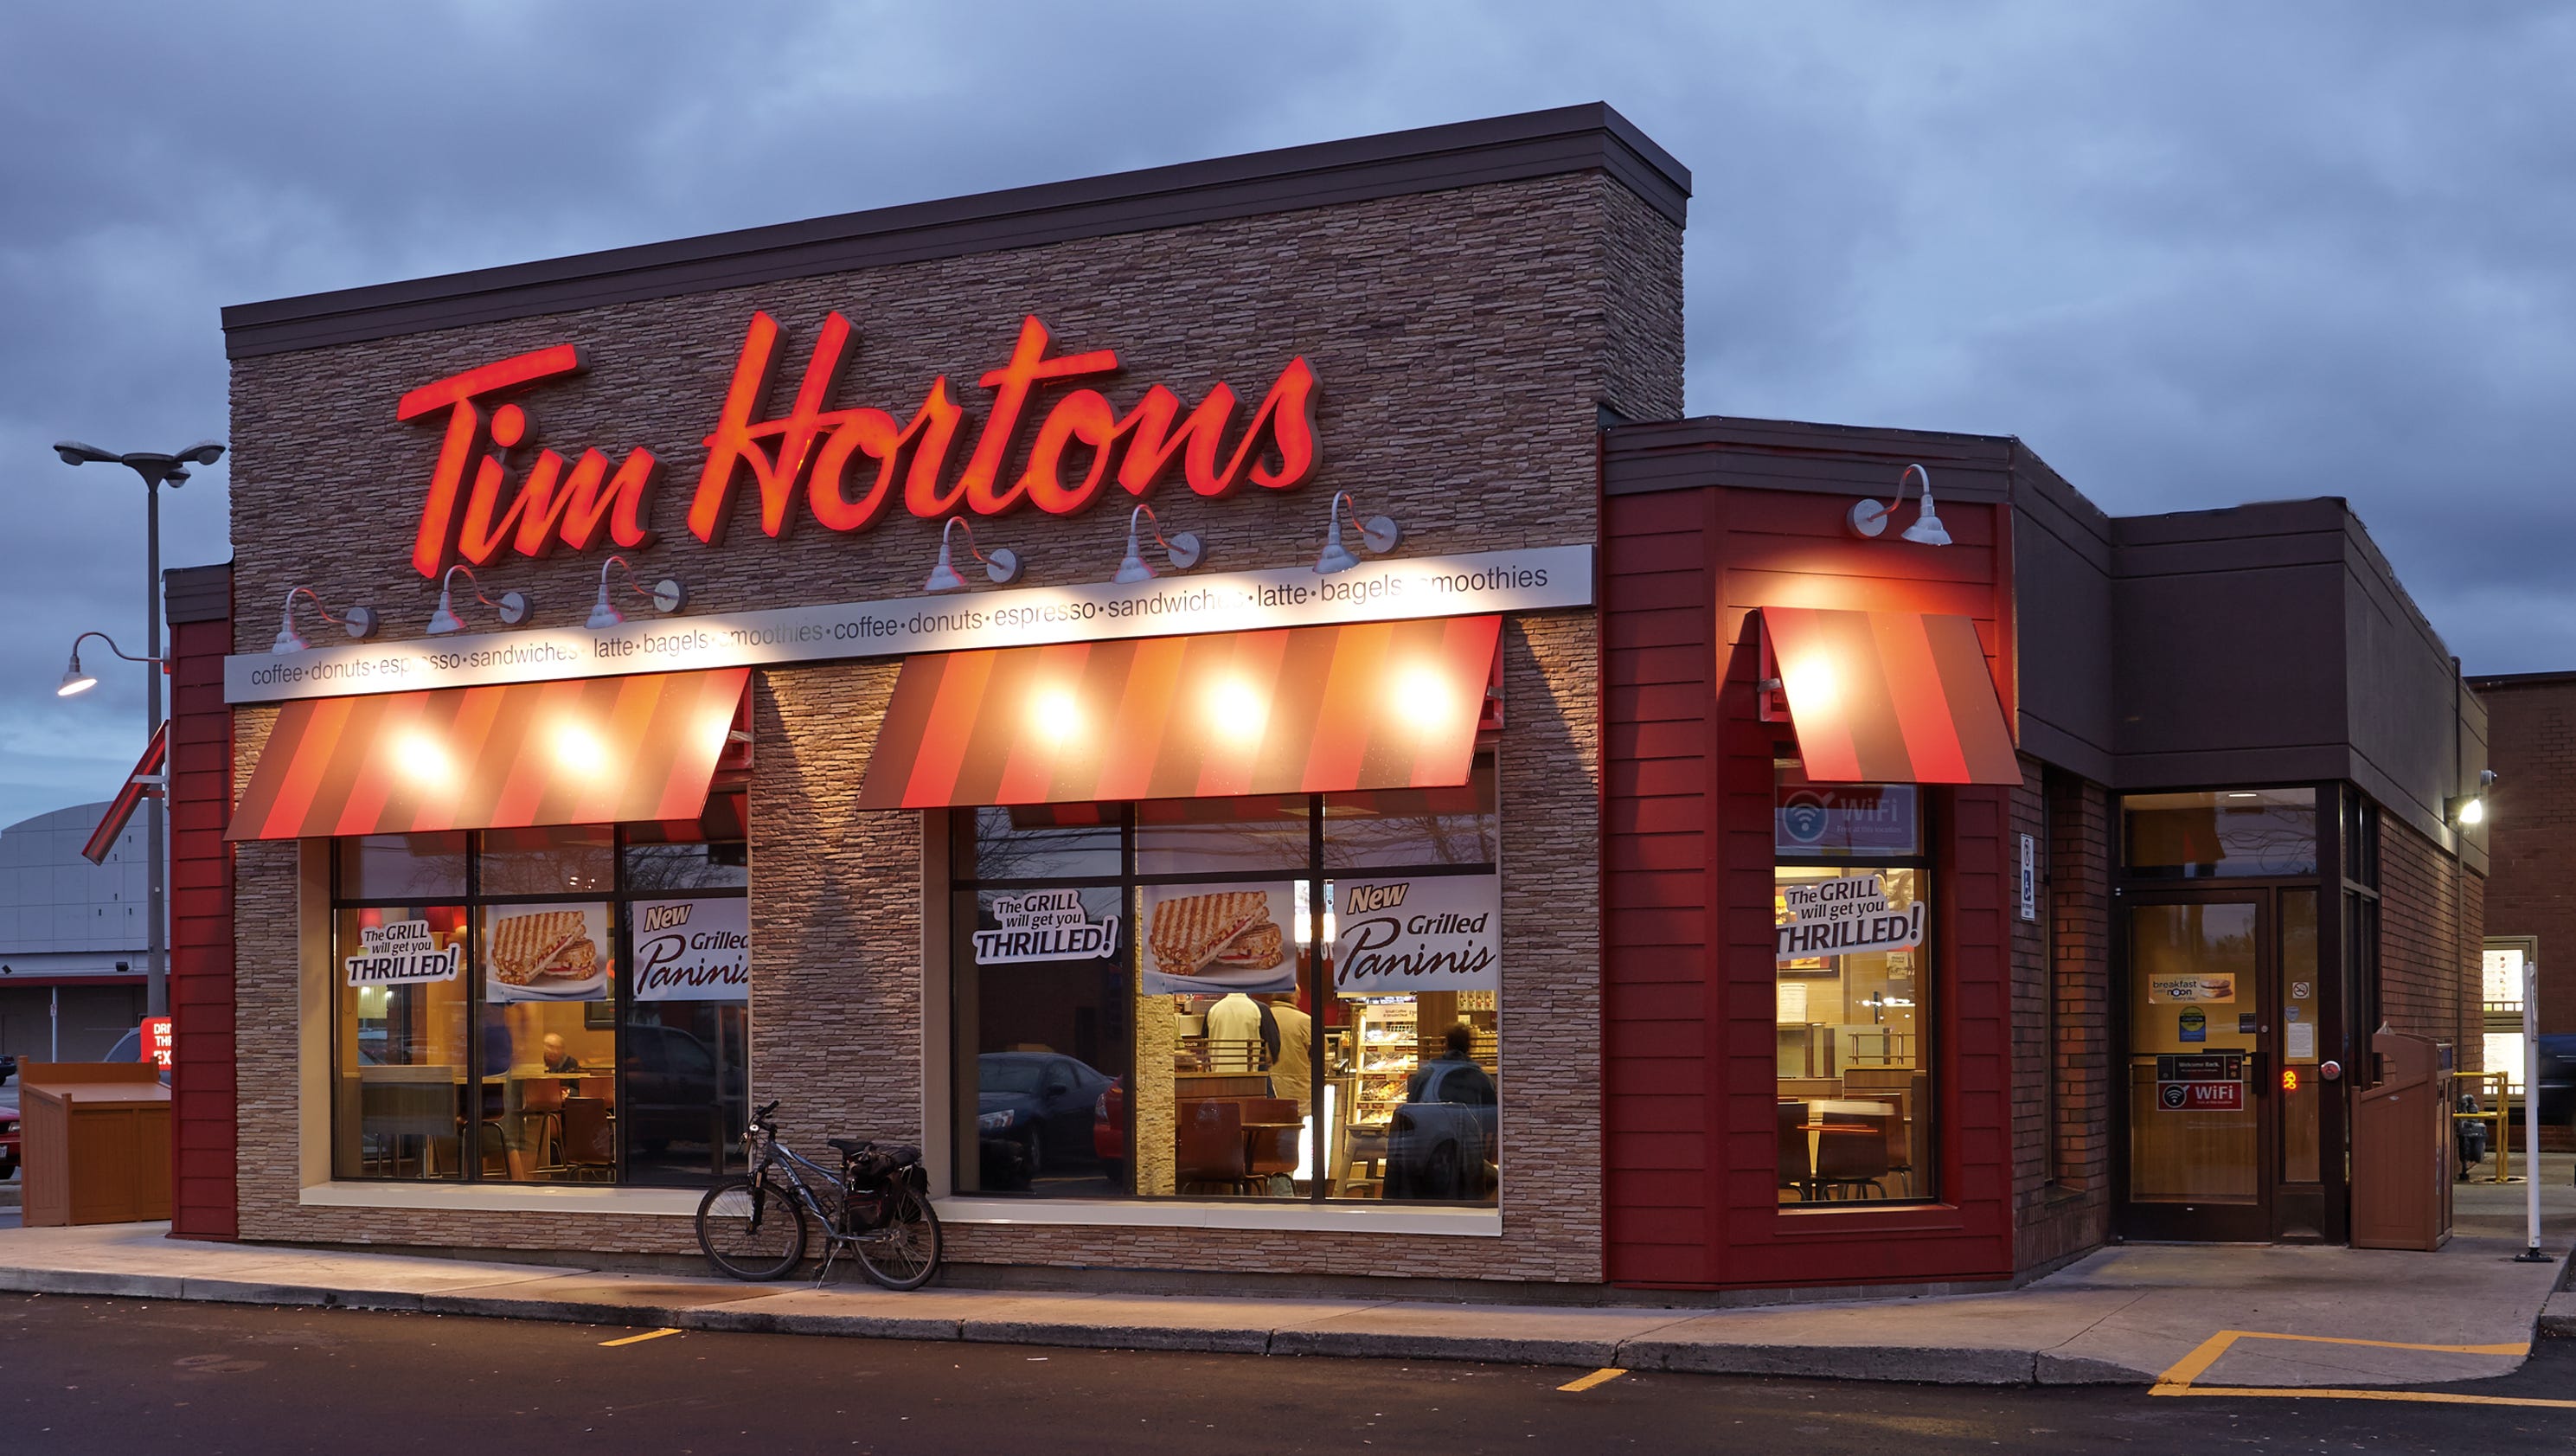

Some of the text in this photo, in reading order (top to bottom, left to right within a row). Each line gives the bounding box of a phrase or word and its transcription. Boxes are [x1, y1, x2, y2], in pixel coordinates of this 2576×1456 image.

[397, 310, 1318, 579] Tim Hortons
[251, 663, 303, 686] coffee
[311, 658, 370, 680] donuts
[379, 653, 460, 677] espsso
[593, 637, 634, 658] latte
[644, 629, 708, 657] bagels
[834, 615, 898, 640] coffee
[908, 608, 983, 634] donuts
[995, 602, 1096, 630] espresso
[1108, 589, 1244, 618] sandwich
[1258, 584, 1308, 606] latte
[1322, 574, 1402, 605] bagels
[1417, 565, 1548, 593] moothies
[1840, 798, 1898, 822] WiFi
[1346, 882, 1410, 915] New
[1789, 879, 1879, 905] The GRILL
[997, 894, 1076, 914] The GRILL
[1801, 901, 1885, 920] will get you
[644, 904, 693, 933] New
[1006, 913, 1081, 930] will get you
[1407, 912, 1489, 935] Grilled
[1776, 905, 1920, 954] THRILLED!
[364, 923, 427, 941] The GRILL
[977, 919, 1114, 959] THRILLED!
[372, 941, 432, 956] will get you
[1338, 917, 1496, 985] Paninis
[349, 946, 457, 981] THRILLED!
[2152, 979, 2197, 988] breakfast
[153, 1023, 171, 1035] DRI
[154, 1036, 172, 1047] TH
[153, 1050, 172, 1065] EX
[2195, 1085, 2233, 1100] WiFi
